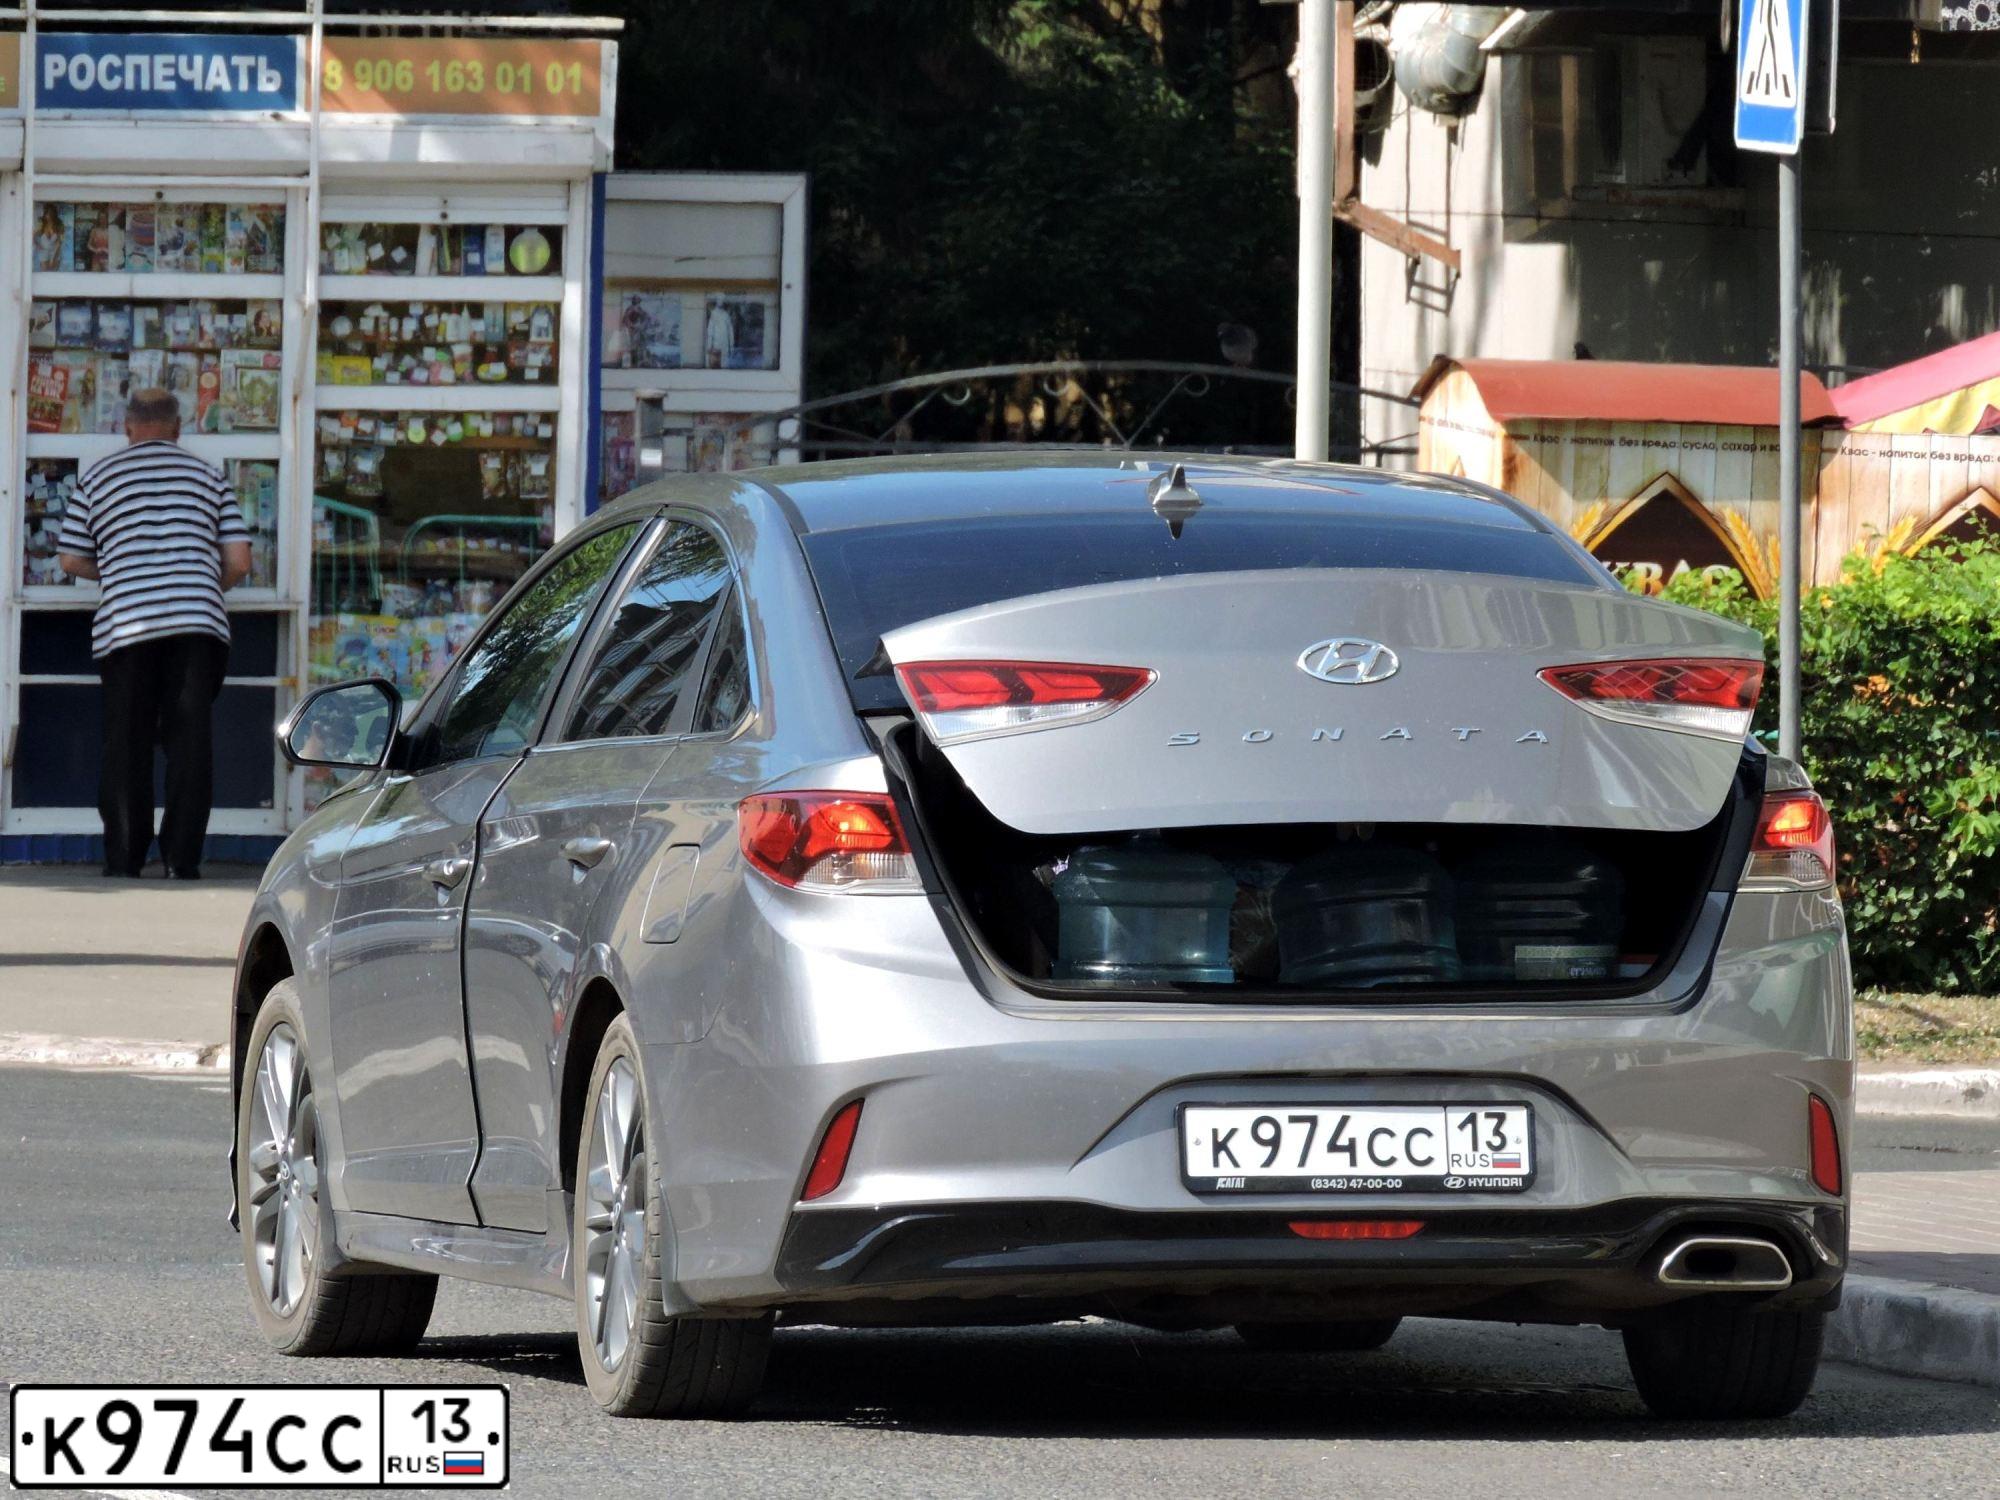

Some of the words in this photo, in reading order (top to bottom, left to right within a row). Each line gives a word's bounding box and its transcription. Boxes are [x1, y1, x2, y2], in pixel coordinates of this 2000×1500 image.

[44, 53, 282, 93] РОСПЕЧАТЬ
[323, 60, 343, 92] 8
[354, 60, 414, 93] 906
[426, 60, 484, 93] 163
[496, 62, 532, 94] 01
[546, 62, 583, 95] 01
[1533, 434, 1560, 445] Квас
[1571, 437, 1615, 447] напиток
[1619, 437, 1639, 447] без
[1642, 439, 1680, 452] вреда:
[1721, 443, 1757, 452] сахар
[1841, 446, 1869, 456] Квас
[1880, 450, 1927, 460] напиток
[1930, 451, 1950, 461] без
[1954, 453, 1994, 463] вреда:
[1167, 726, 1549, 747] SONATA
[1457, 1111, 1508, 1152] 13
[1451, 1153, 1490, 1168] RUS
[1311, 1178, 1347, 1189] (8342)
[1349, 1178, 1402, 1189] 47-00-00
[1468, 1177, 1523, 1187] HYUNDAI
